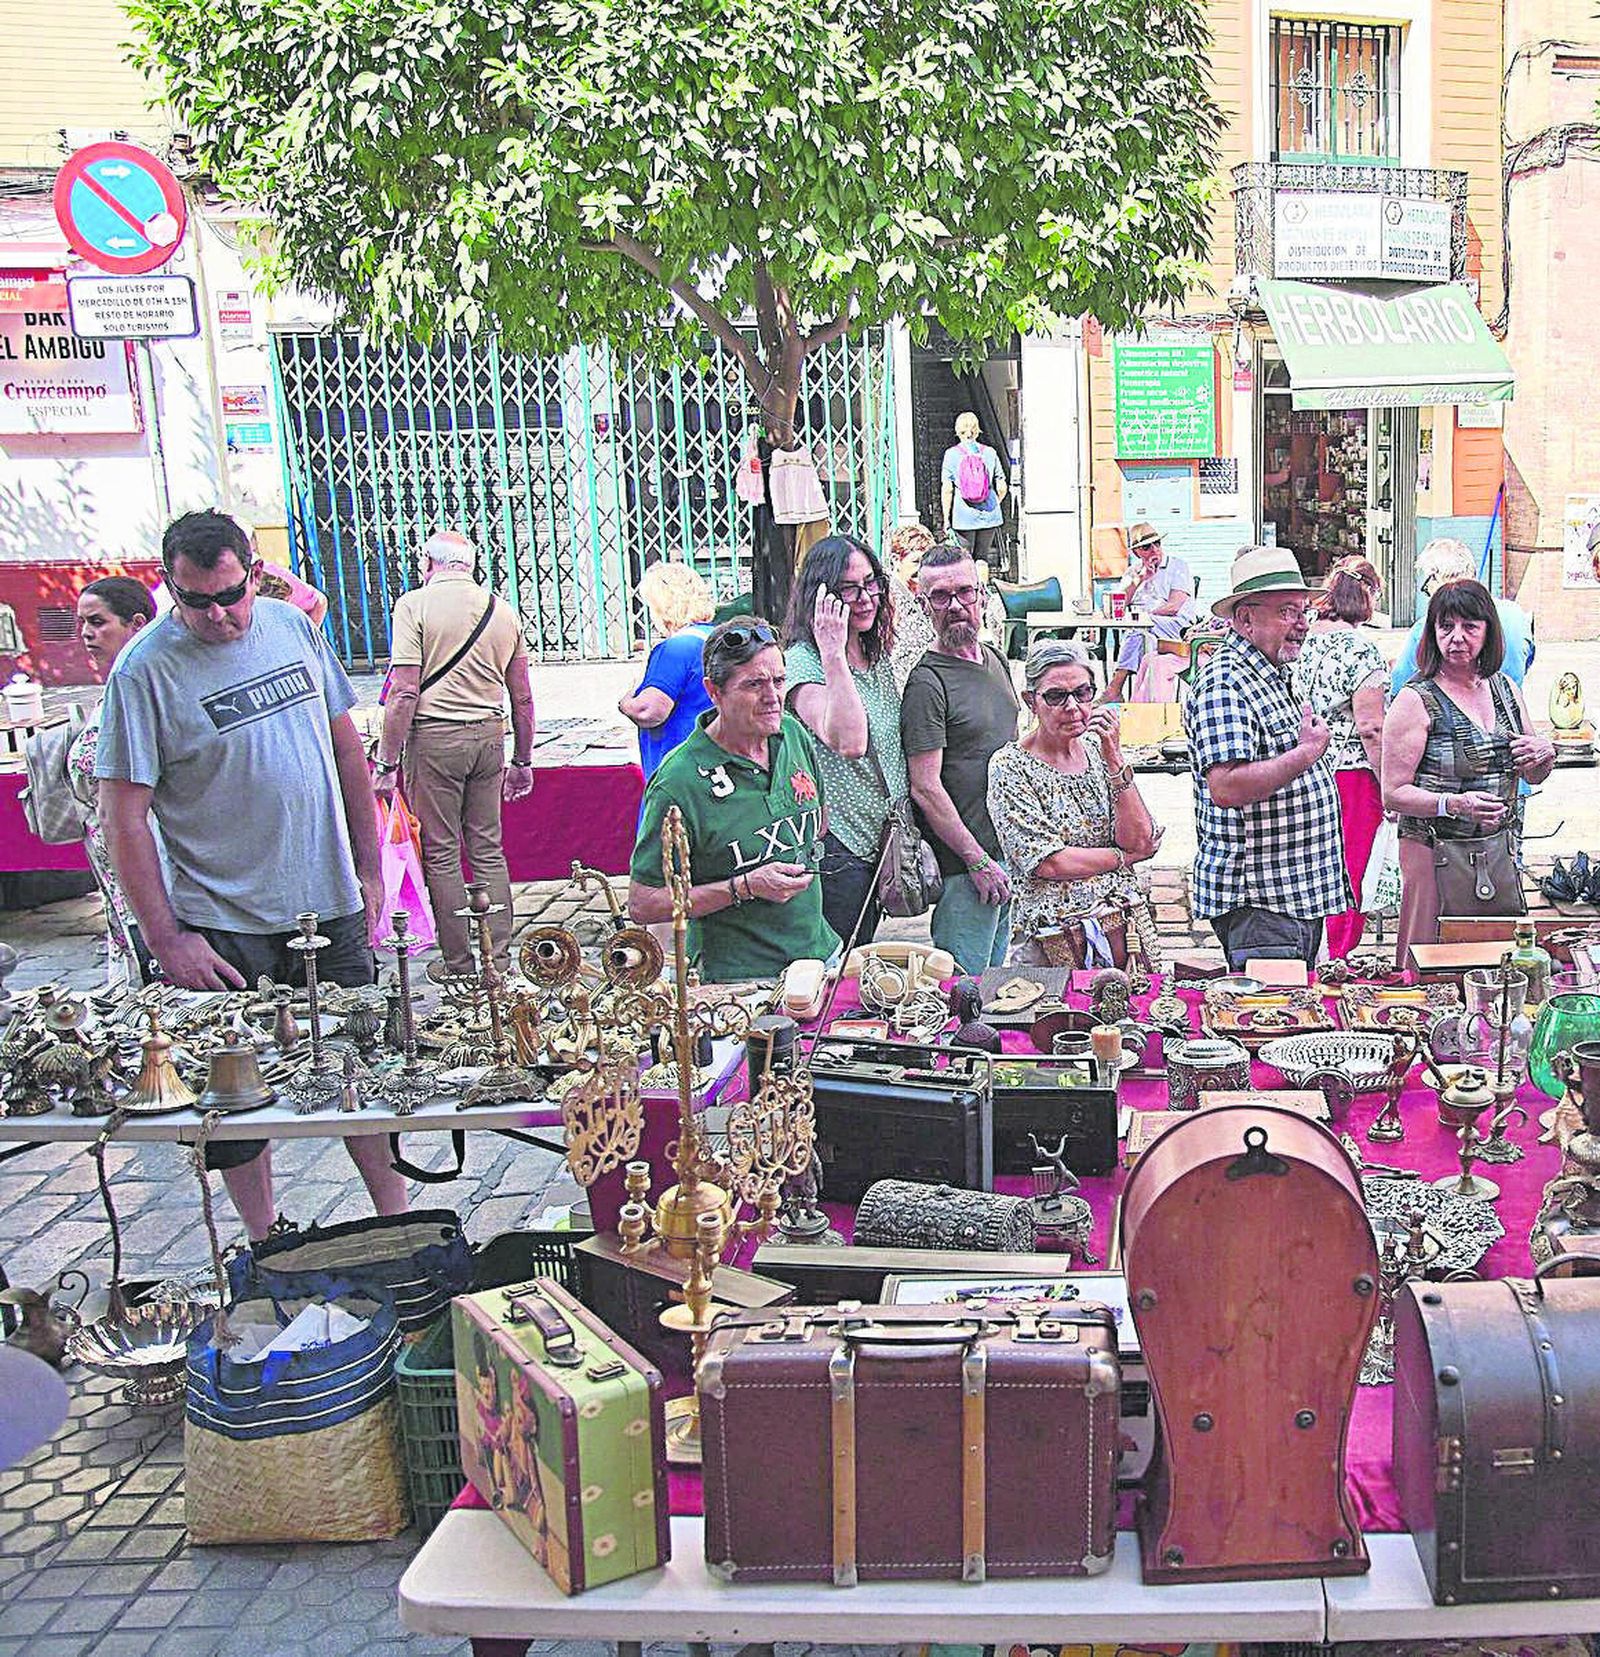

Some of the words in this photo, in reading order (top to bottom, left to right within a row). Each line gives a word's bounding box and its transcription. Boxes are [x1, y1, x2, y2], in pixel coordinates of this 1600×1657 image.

[97, 286, 114, 294] LOS
[116, 284, 146, 294] JUEVES
[147, 284, 165, 293] POR
[78, 298, 132, 308] MERCADILLO
[133, 298, 144, 307] DE
[164, 297, 170, 305] A
[95, 311, 122, 320] RESTO
[123, 310, 134, 319] DE
[136, 309, 175, 319] HORARIO
[1267, 293, 1477, 346] HERBOLARIO
[103, 323, 125, 332] SOLO
[127, 322, 169, 332] TURISMOS
[4, 382, 107, 401] Cruzcampo
[26, 405, 92, 417] ESPECIAL
[247, 670, 309, 710] PUMA
